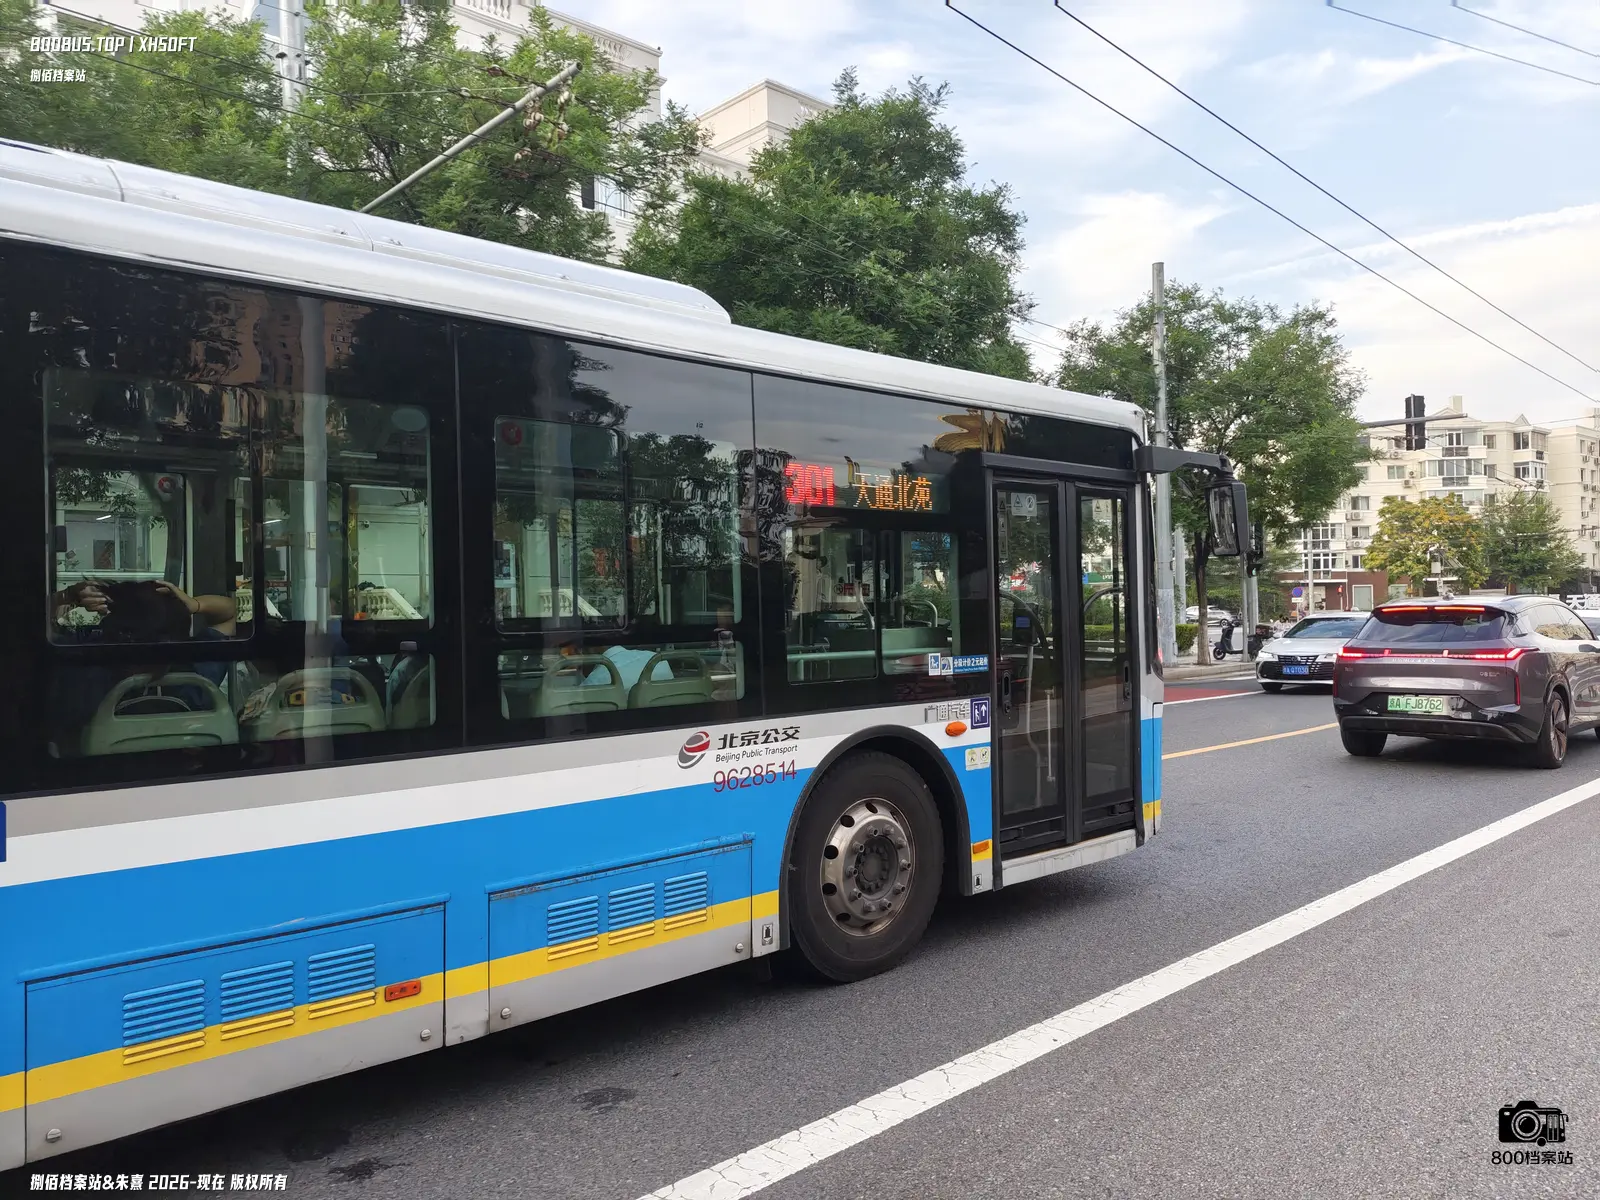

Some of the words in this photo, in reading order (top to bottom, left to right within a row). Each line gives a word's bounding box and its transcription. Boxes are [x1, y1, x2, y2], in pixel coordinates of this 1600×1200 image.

[785, 463, 834, 506] 301
[852, 472, 933, 511] 天通北苑
[715, 753, 740, 763] Beijing
[741, 749, 763, 758] Public
[765, 744, 798, 755] Transport
[717, 726, 800, 750] 北京公交
[713, 759, 798, 793] 9628514
